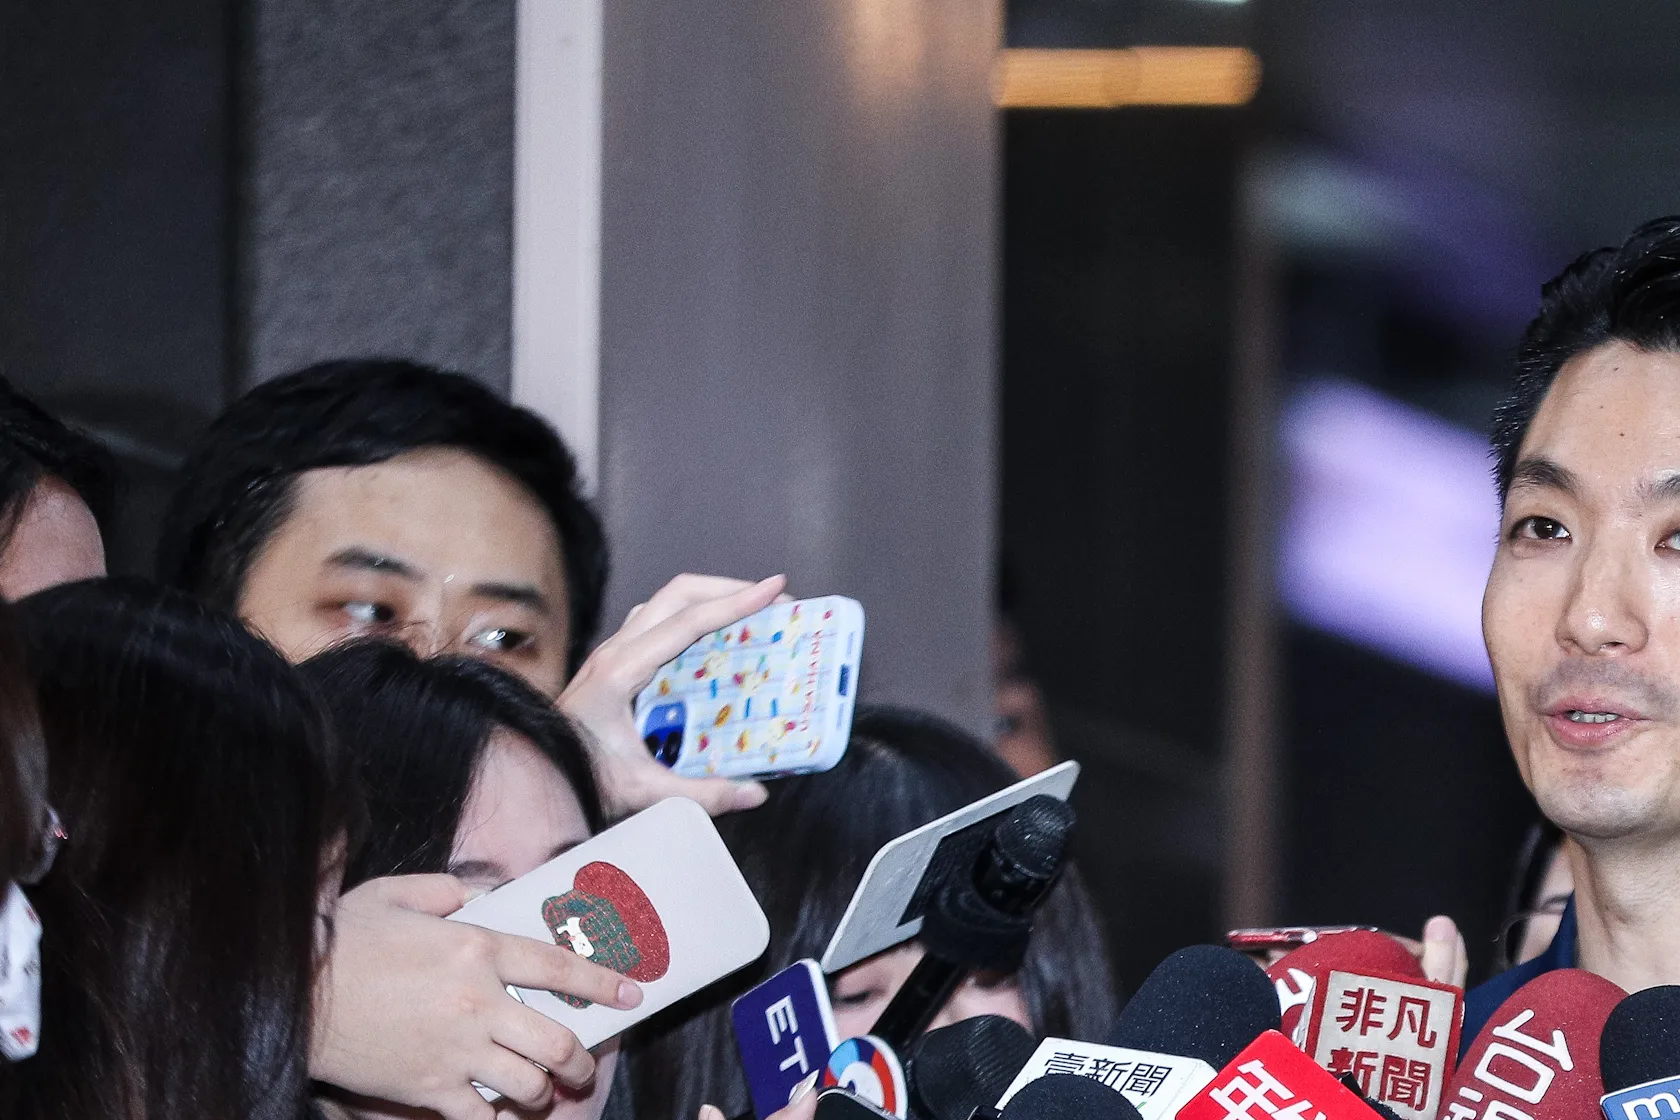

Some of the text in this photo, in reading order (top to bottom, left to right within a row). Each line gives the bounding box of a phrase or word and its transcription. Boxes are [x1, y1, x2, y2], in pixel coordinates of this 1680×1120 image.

[765, 994, 809, 1101] ET
[1336, 986, 1437, 1049] 非凡
[1328, 1046, 1432, 1112] 新聞
